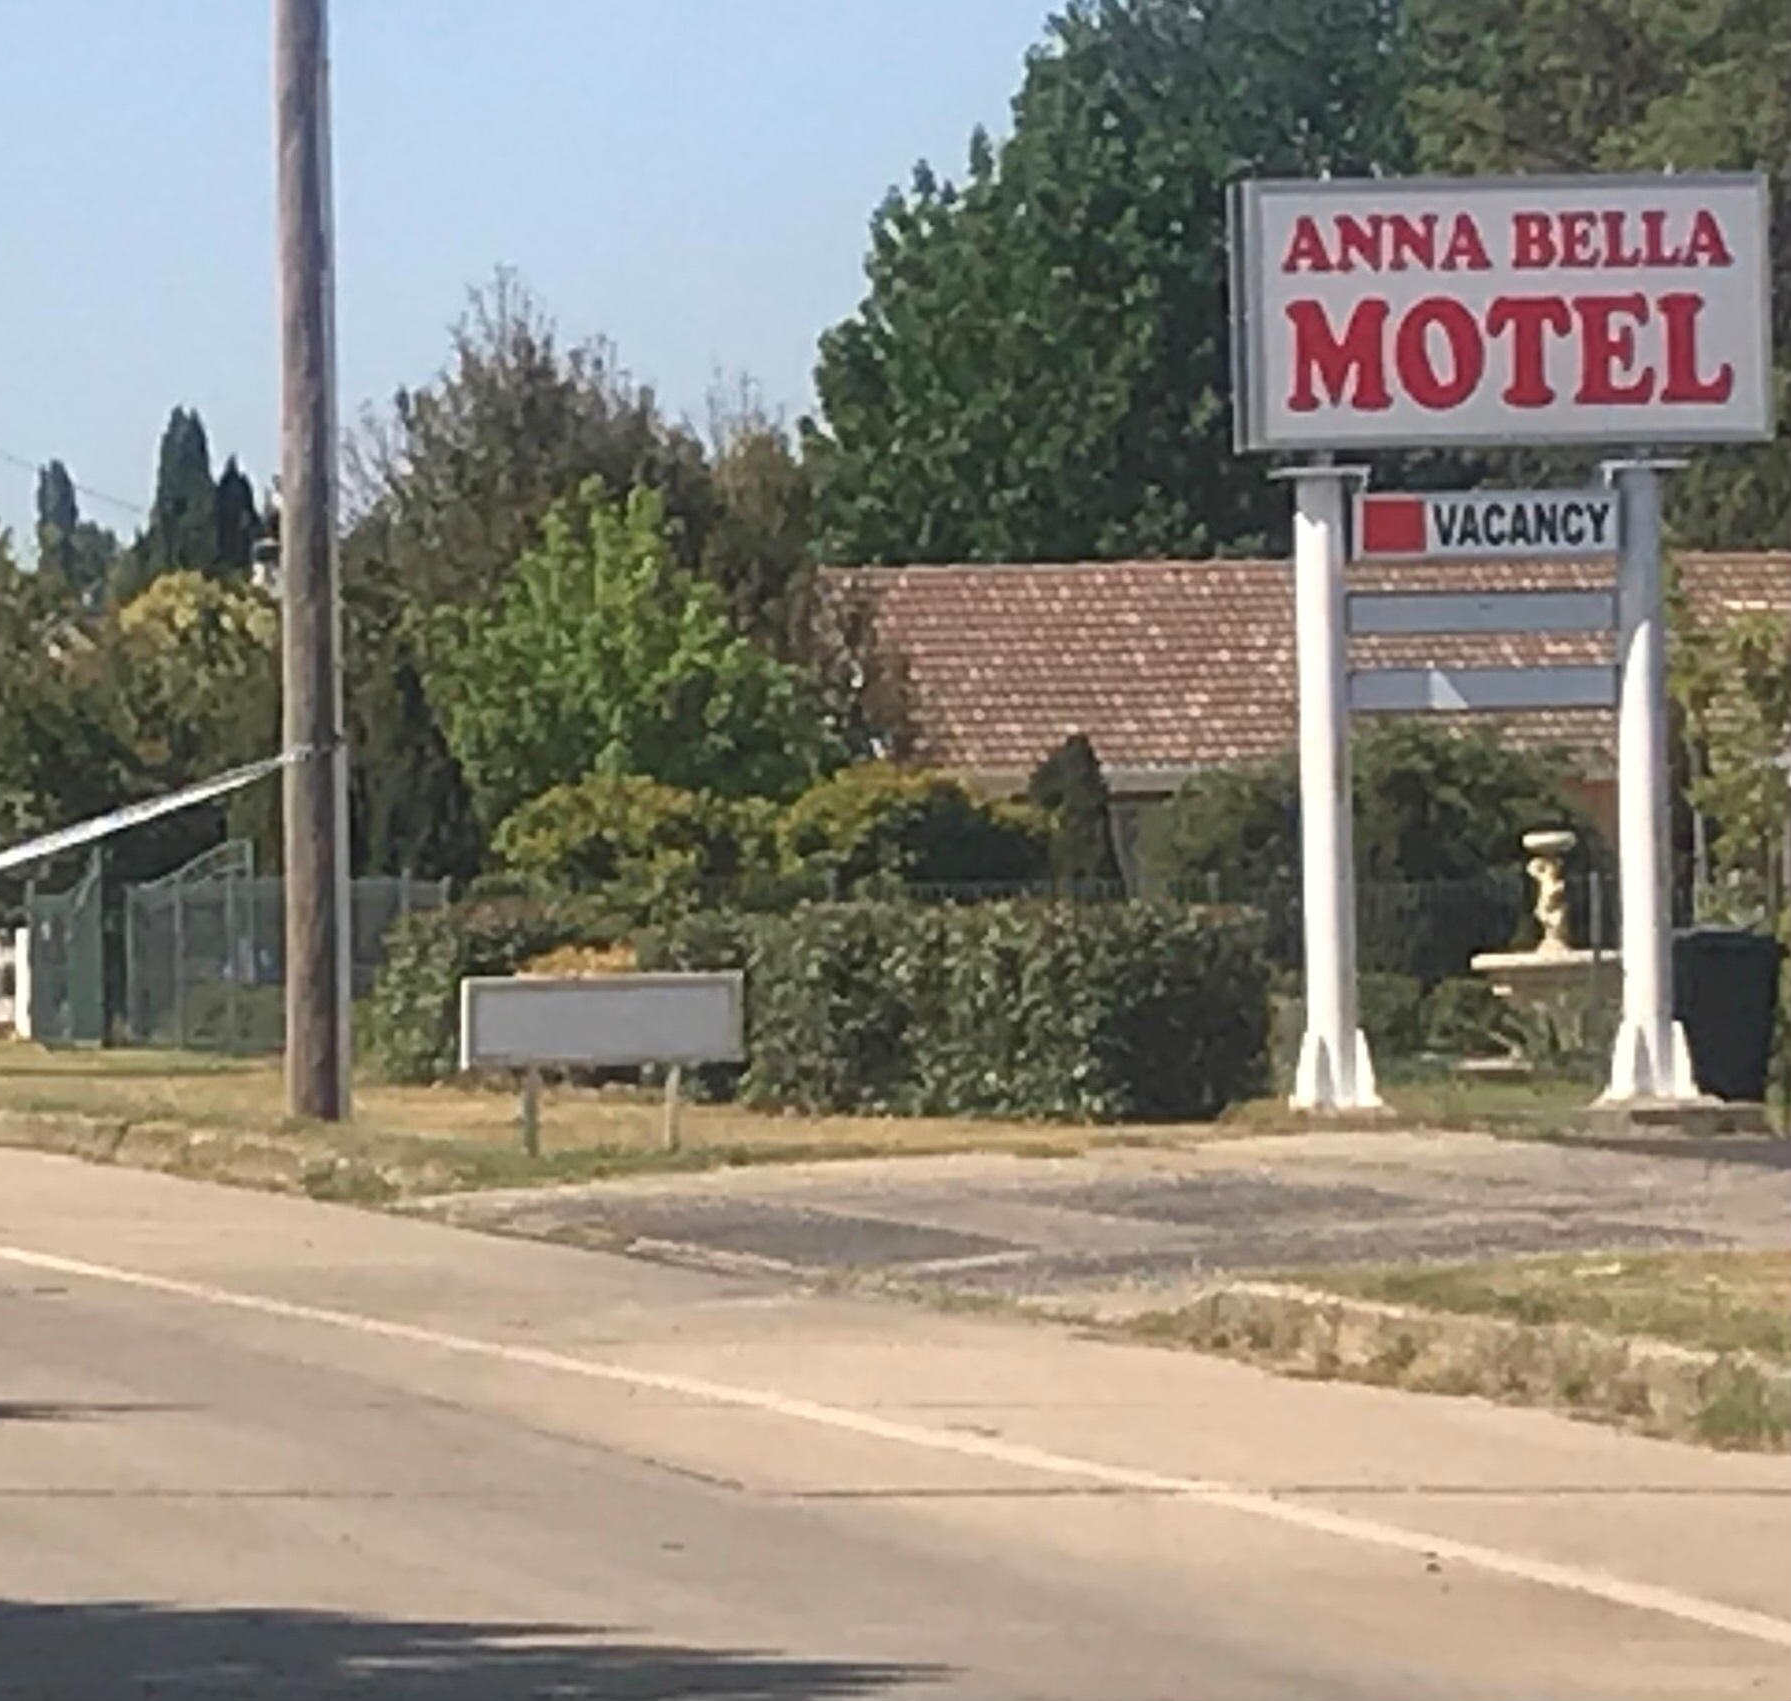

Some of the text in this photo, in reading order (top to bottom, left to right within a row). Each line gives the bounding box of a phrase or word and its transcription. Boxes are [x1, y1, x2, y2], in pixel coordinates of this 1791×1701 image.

[1283, 210, 1733, 273] ANNA BELLA
[1285, 293, 1733, 412] MOTEL
[1433, 503, 1609, 547] VACANCY
